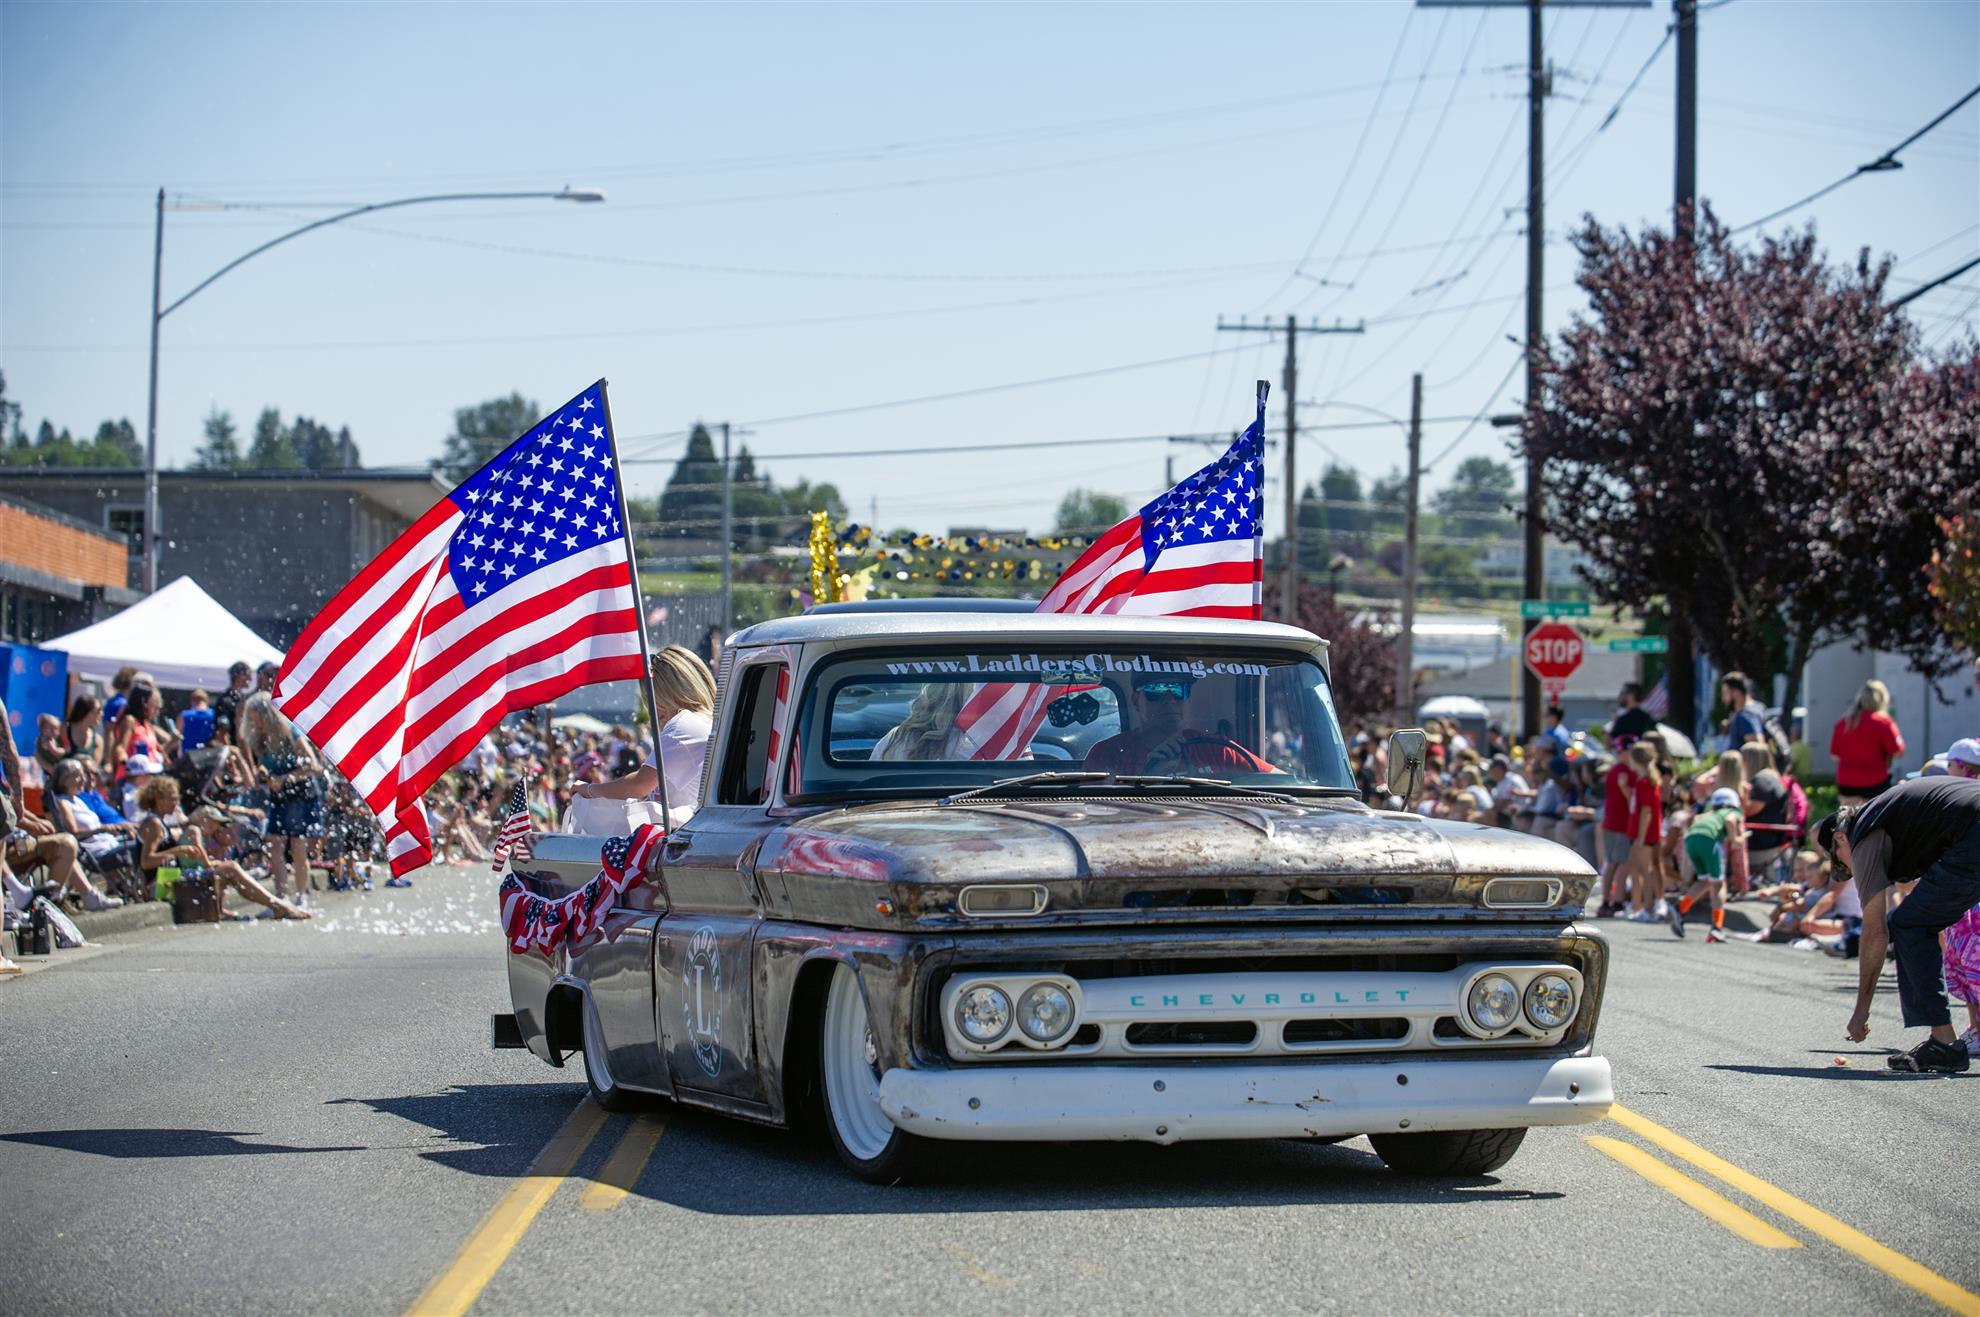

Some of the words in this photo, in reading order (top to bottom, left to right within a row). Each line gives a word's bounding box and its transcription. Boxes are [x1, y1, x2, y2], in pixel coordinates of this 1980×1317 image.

[1528, 638, 1581, 665] STOP
[886, 653, 1270, 679] www.LaddersClothing.com
[694, 965, 712, 1036] L
[1130, 990, 1410, 1007] CHEVROLET
